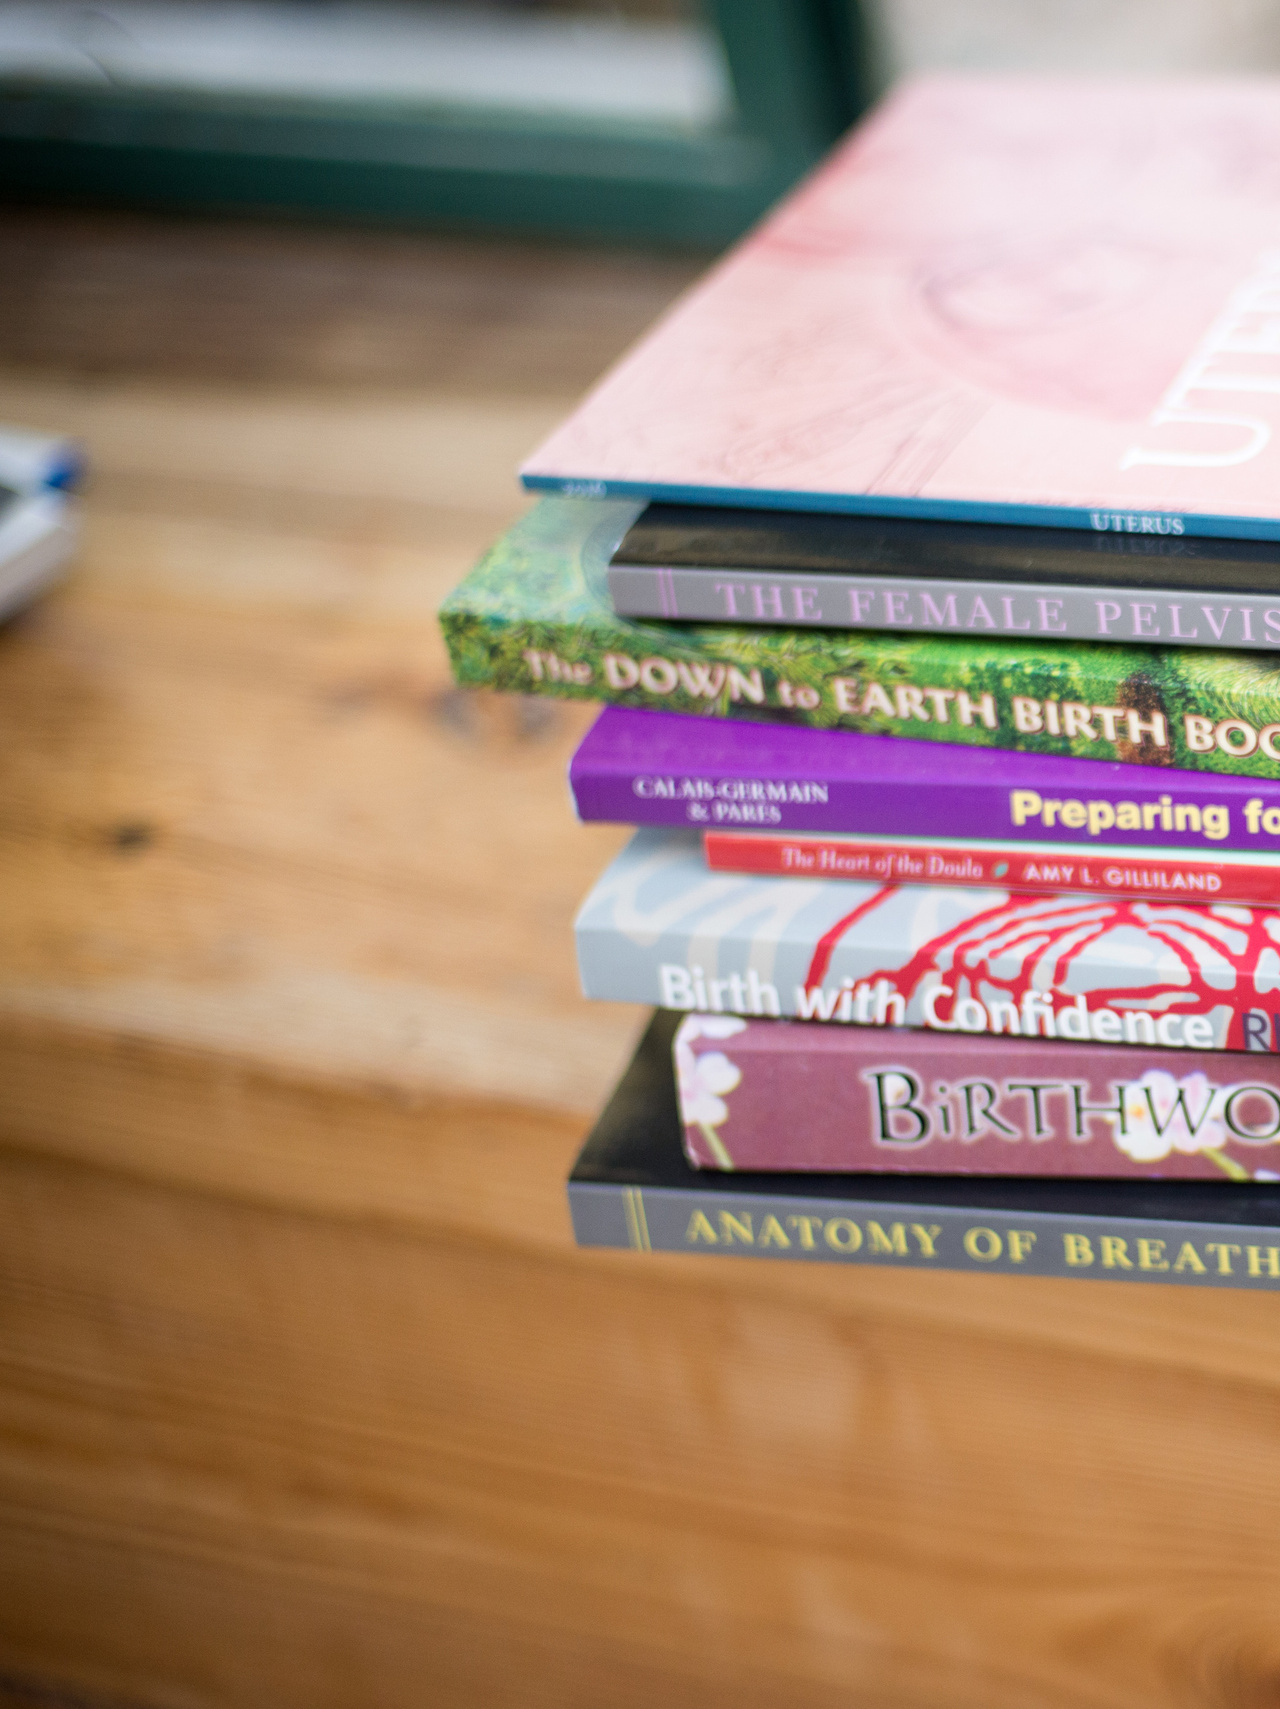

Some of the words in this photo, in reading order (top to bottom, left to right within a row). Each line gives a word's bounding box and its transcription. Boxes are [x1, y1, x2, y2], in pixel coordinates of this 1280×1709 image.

[1089, 511, 1185, 536] UTERUS
[715, 582, 823, 623] THE
[850, 589, 1068, 633] FEMALE
[523, 650, 593, 685] The
[603, 654, 765, 704] DOWN
[778, 681, 821, 710] to
[837, 681, 999, 729] EARTH
[1014, 696, 1170, 749] BIRTH
[632, 775, 829, 803] CALAIS-GERMAIN
[687, 801, 711, 822] &
[1011, 790, 1231, 841] Preparing
[782, 846, 814, 869] The
[819, 848, 871, 872] Heart
[875, 852, 897, 878] of
[898, 852, 923, 876] the
[929, 853, 983, 879] Doula
[1023, 862, 1075, 884] AMY
[1080, 865, 1099, 885] L.
[1103, 867, 1223, 892] GILLILAND
[659, 962, 781, 1016] Birth
[796, 978, 905, 1025] with
[921, 985, 1215, 1048] Confidence
[684, 1209, 942, 1257] ANATOMY
[963, 1225, 1037, 1263] OF
